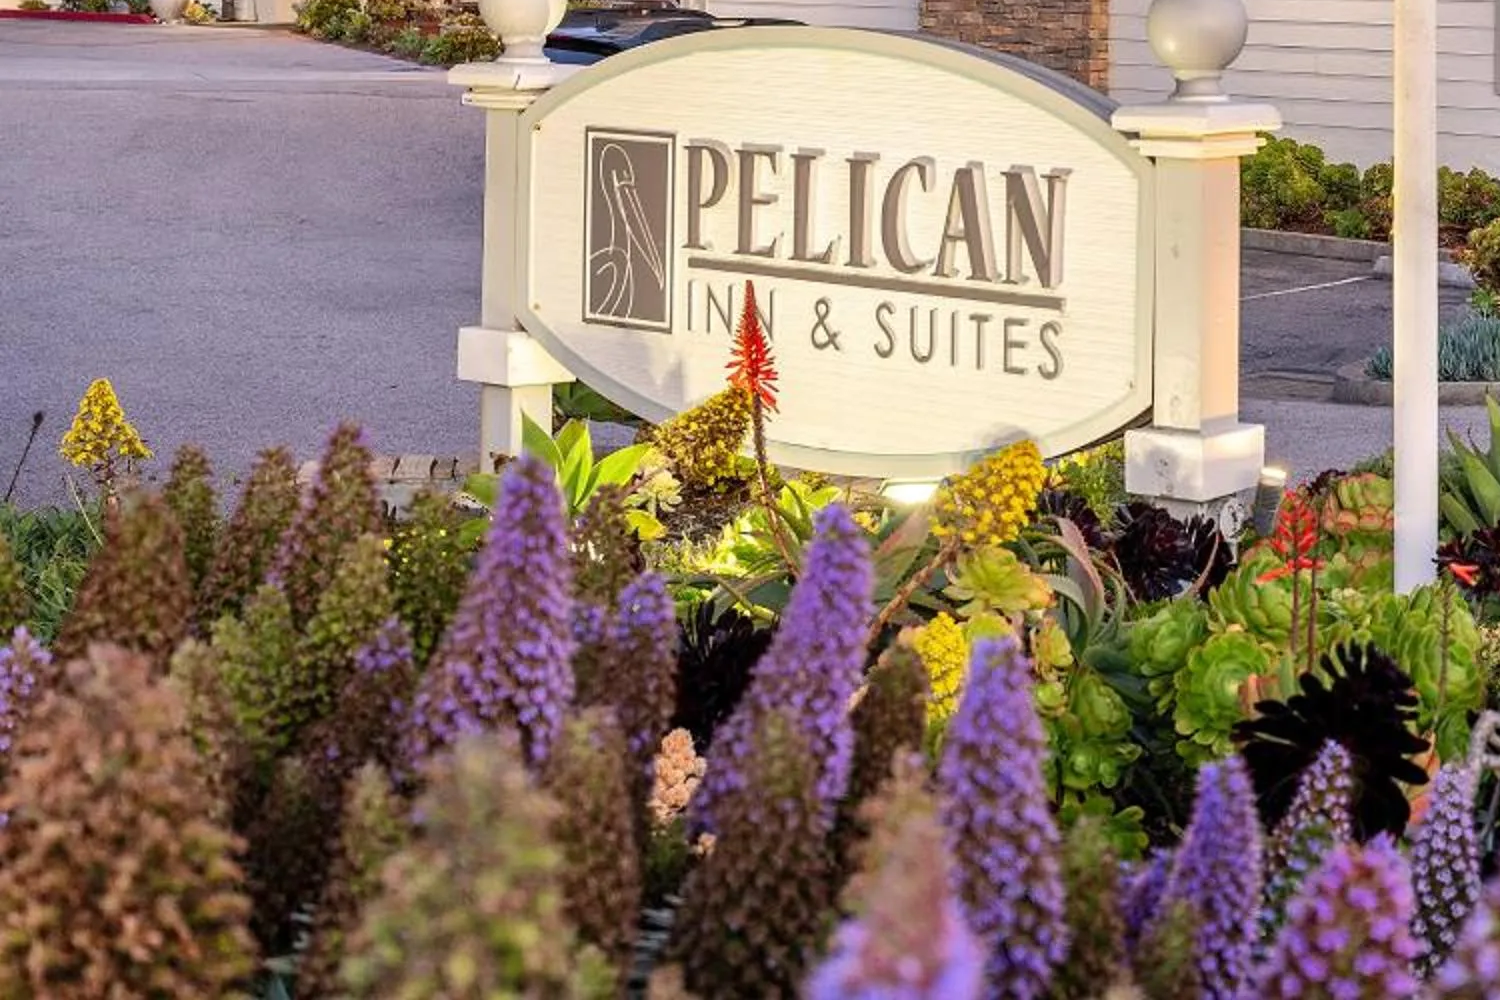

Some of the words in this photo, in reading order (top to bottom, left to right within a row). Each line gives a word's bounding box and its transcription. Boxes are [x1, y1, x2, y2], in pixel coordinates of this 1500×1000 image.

[682, 138, 1073, 288] PELICAN
[811, 297, 841, 352] &
[873, 300, 1063, 380] SUITES
